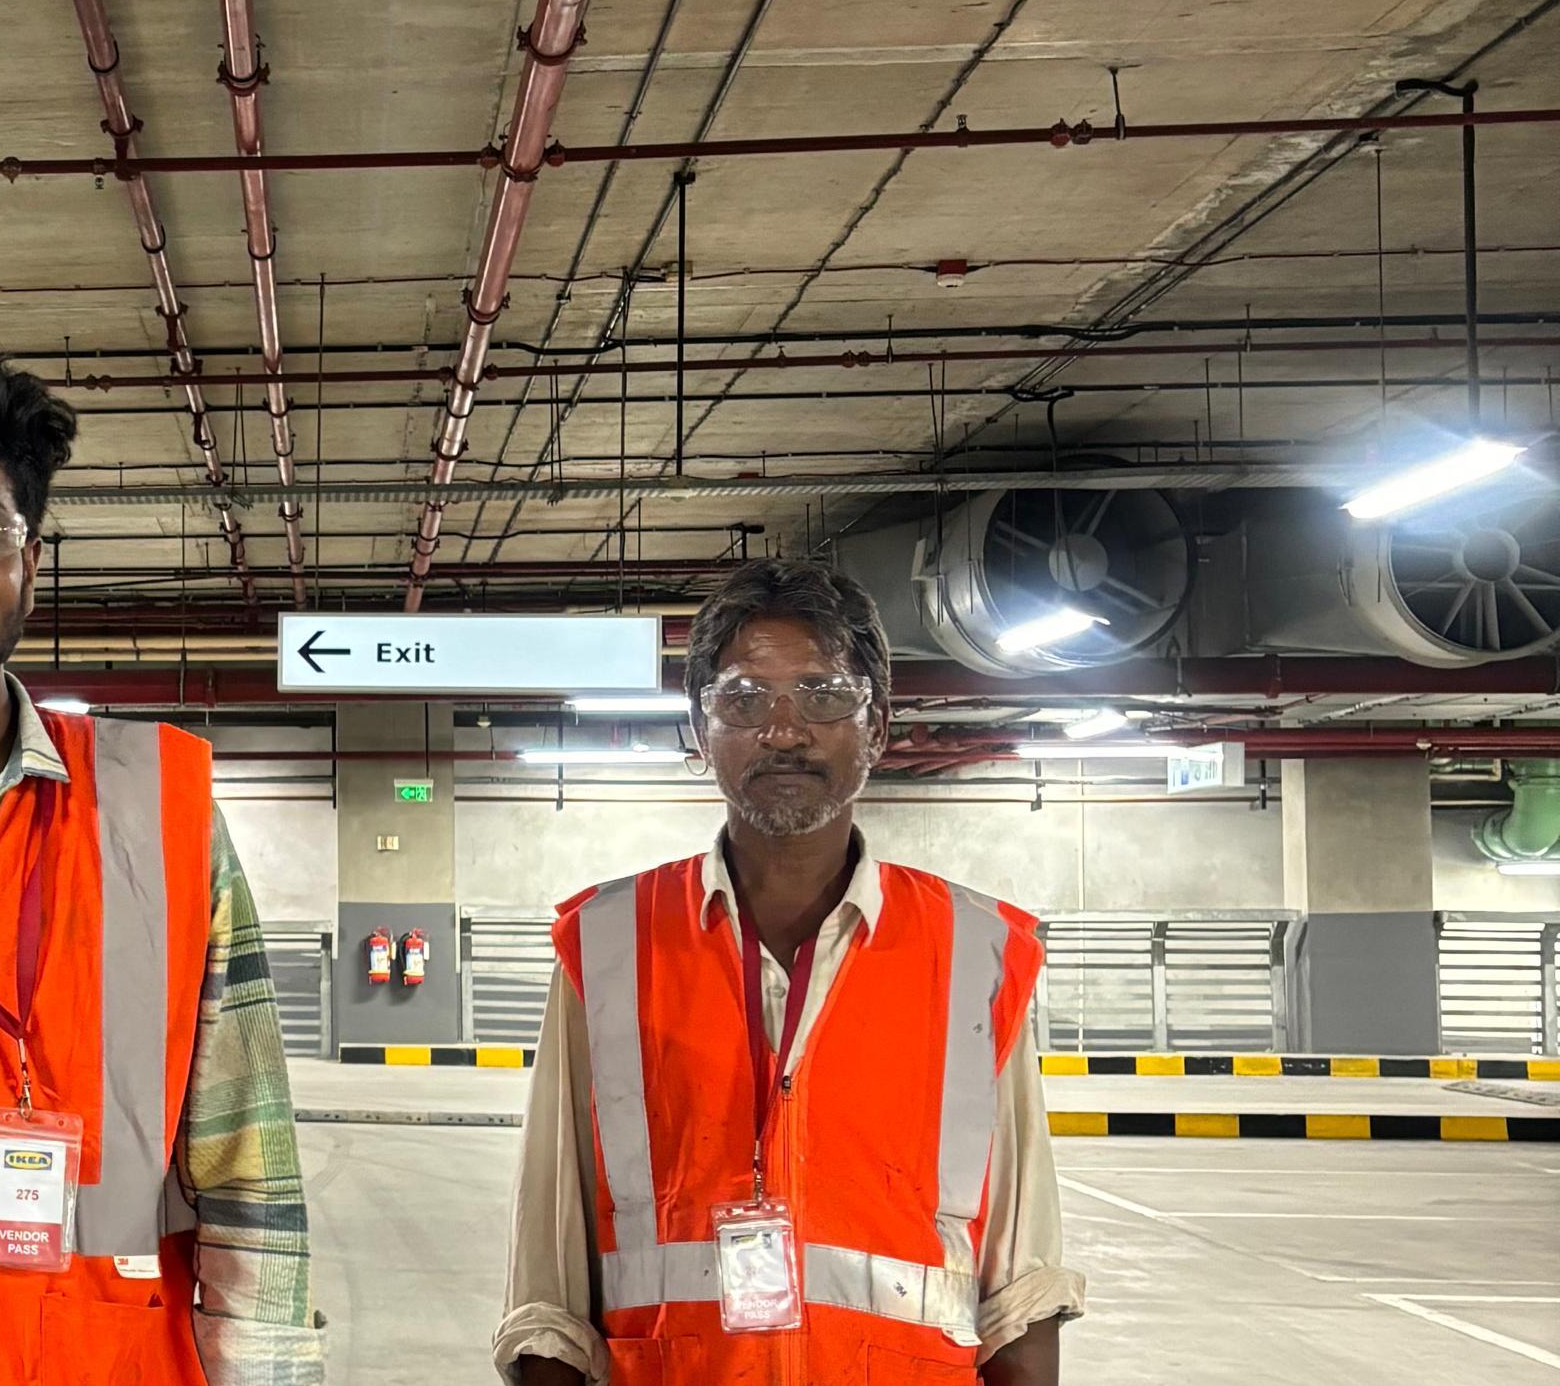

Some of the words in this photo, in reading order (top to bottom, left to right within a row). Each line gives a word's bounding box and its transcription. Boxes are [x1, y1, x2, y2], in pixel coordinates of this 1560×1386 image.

[376, 643, 435, 663] Exit
[16, 1189, 39, 1201] 275
[7, 1243, 39, 1256] PASS
[733, 1299, 778, 1311] ENDOR
